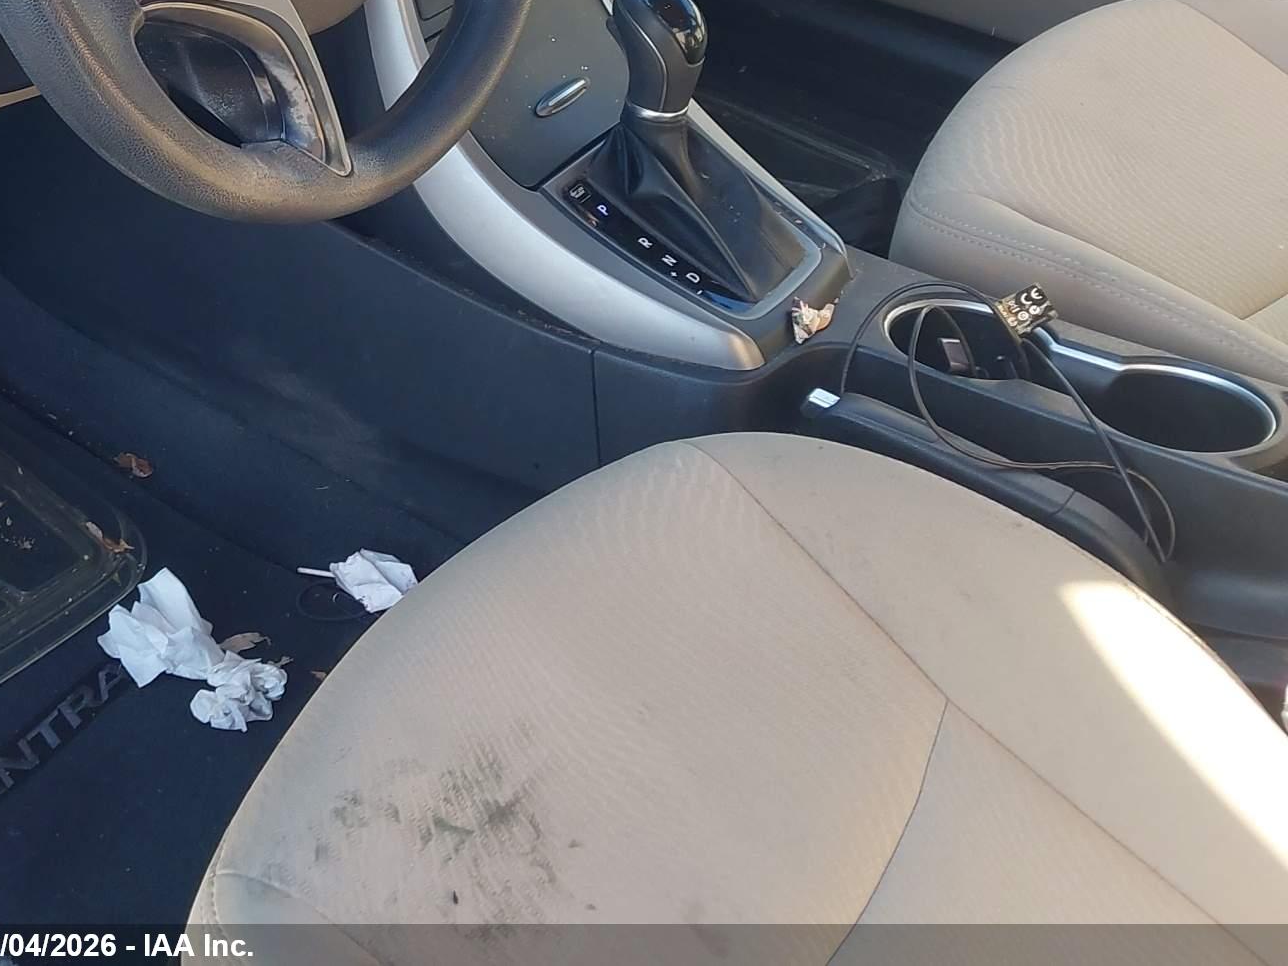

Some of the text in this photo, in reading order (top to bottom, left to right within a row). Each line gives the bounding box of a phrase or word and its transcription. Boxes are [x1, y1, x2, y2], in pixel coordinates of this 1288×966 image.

[596, 204, 609, 216] P
[637, 237, 653, 249] R
[661, 254, 678, 267] N
[685, 272, 701, 284] D
